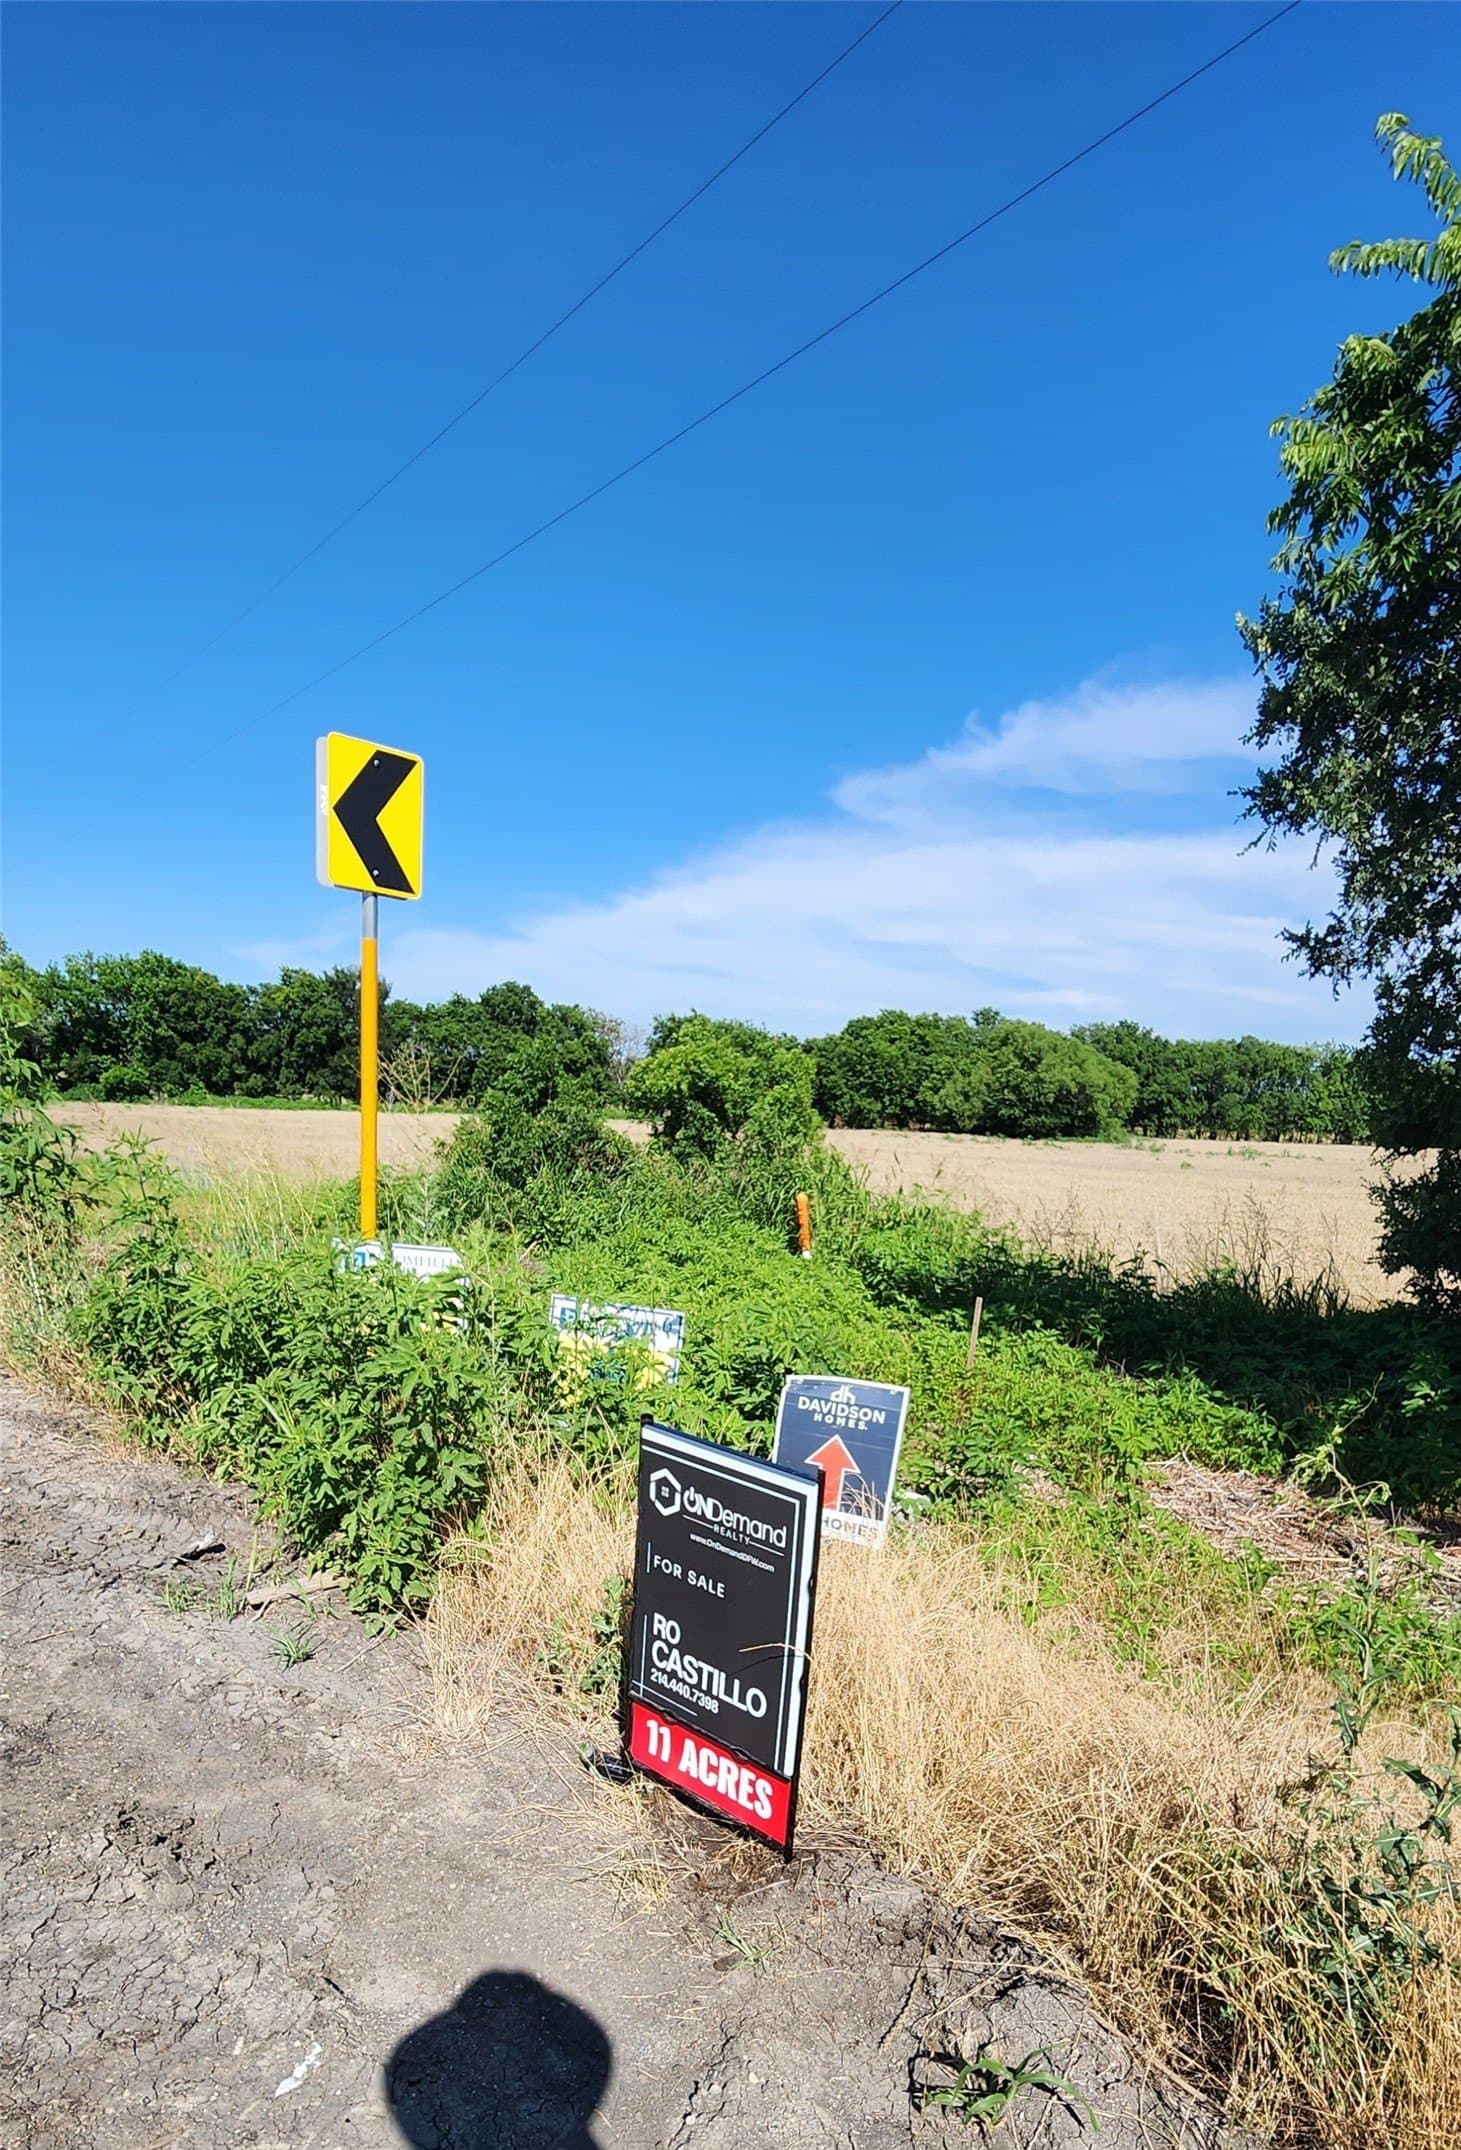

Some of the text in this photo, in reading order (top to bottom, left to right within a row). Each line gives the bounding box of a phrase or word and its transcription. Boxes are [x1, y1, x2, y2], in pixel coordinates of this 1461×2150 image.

[798, 1397, 886, 1424] DAVIDSON
[713, 1524, 750, 1545] REALTY
[653, 1555, 726, 1598] FOR SALE
[653, 1612, 681, 1645] RO
[650, 1668, 719, 1714] 214.440.7398
[652, 1640, 767, 1718] CASTILLO
[646, 1719, 773, 1819] 11 ACRES
